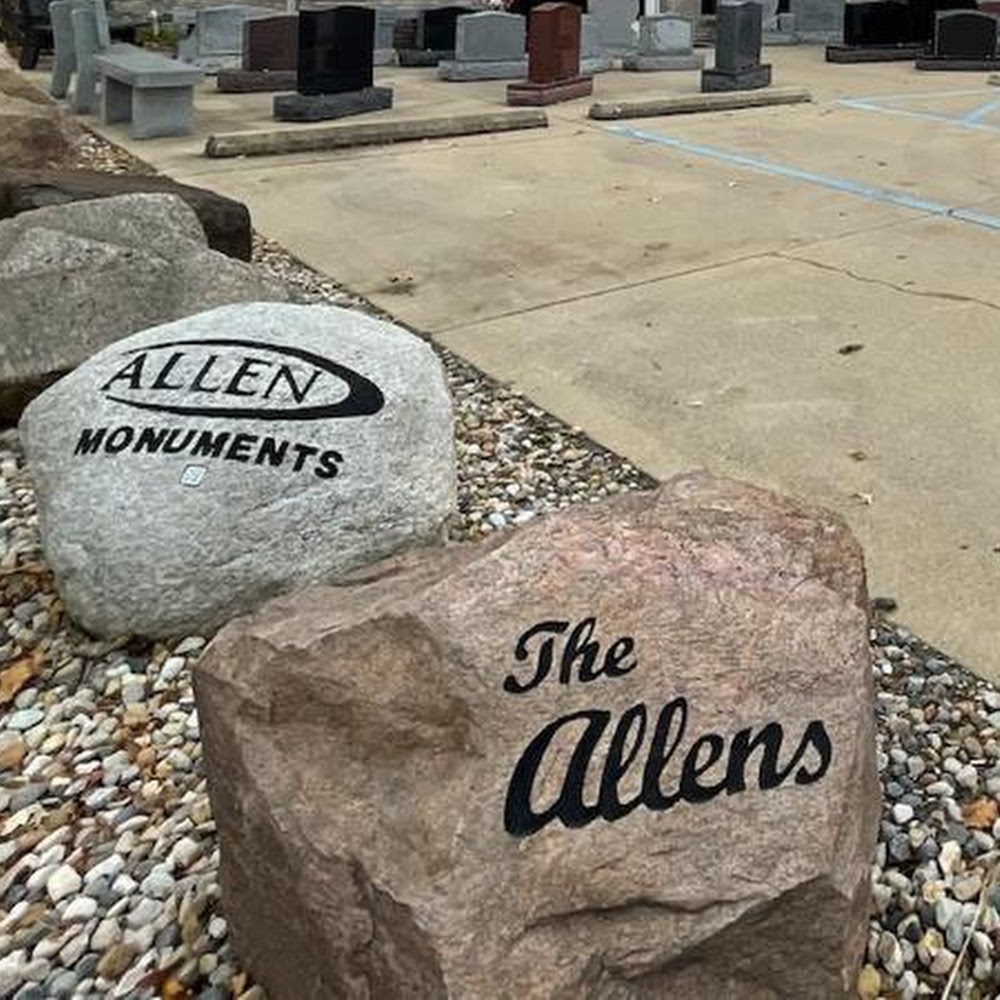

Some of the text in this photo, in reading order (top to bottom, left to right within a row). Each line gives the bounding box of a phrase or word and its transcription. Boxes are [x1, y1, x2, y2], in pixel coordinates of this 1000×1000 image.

[101, 351, 323, 405] ALLEN
[74, 425, 345, 479] MONUMENTS
[503, 617, 638, 694] The
[503, 696, 833, 837] Allens
